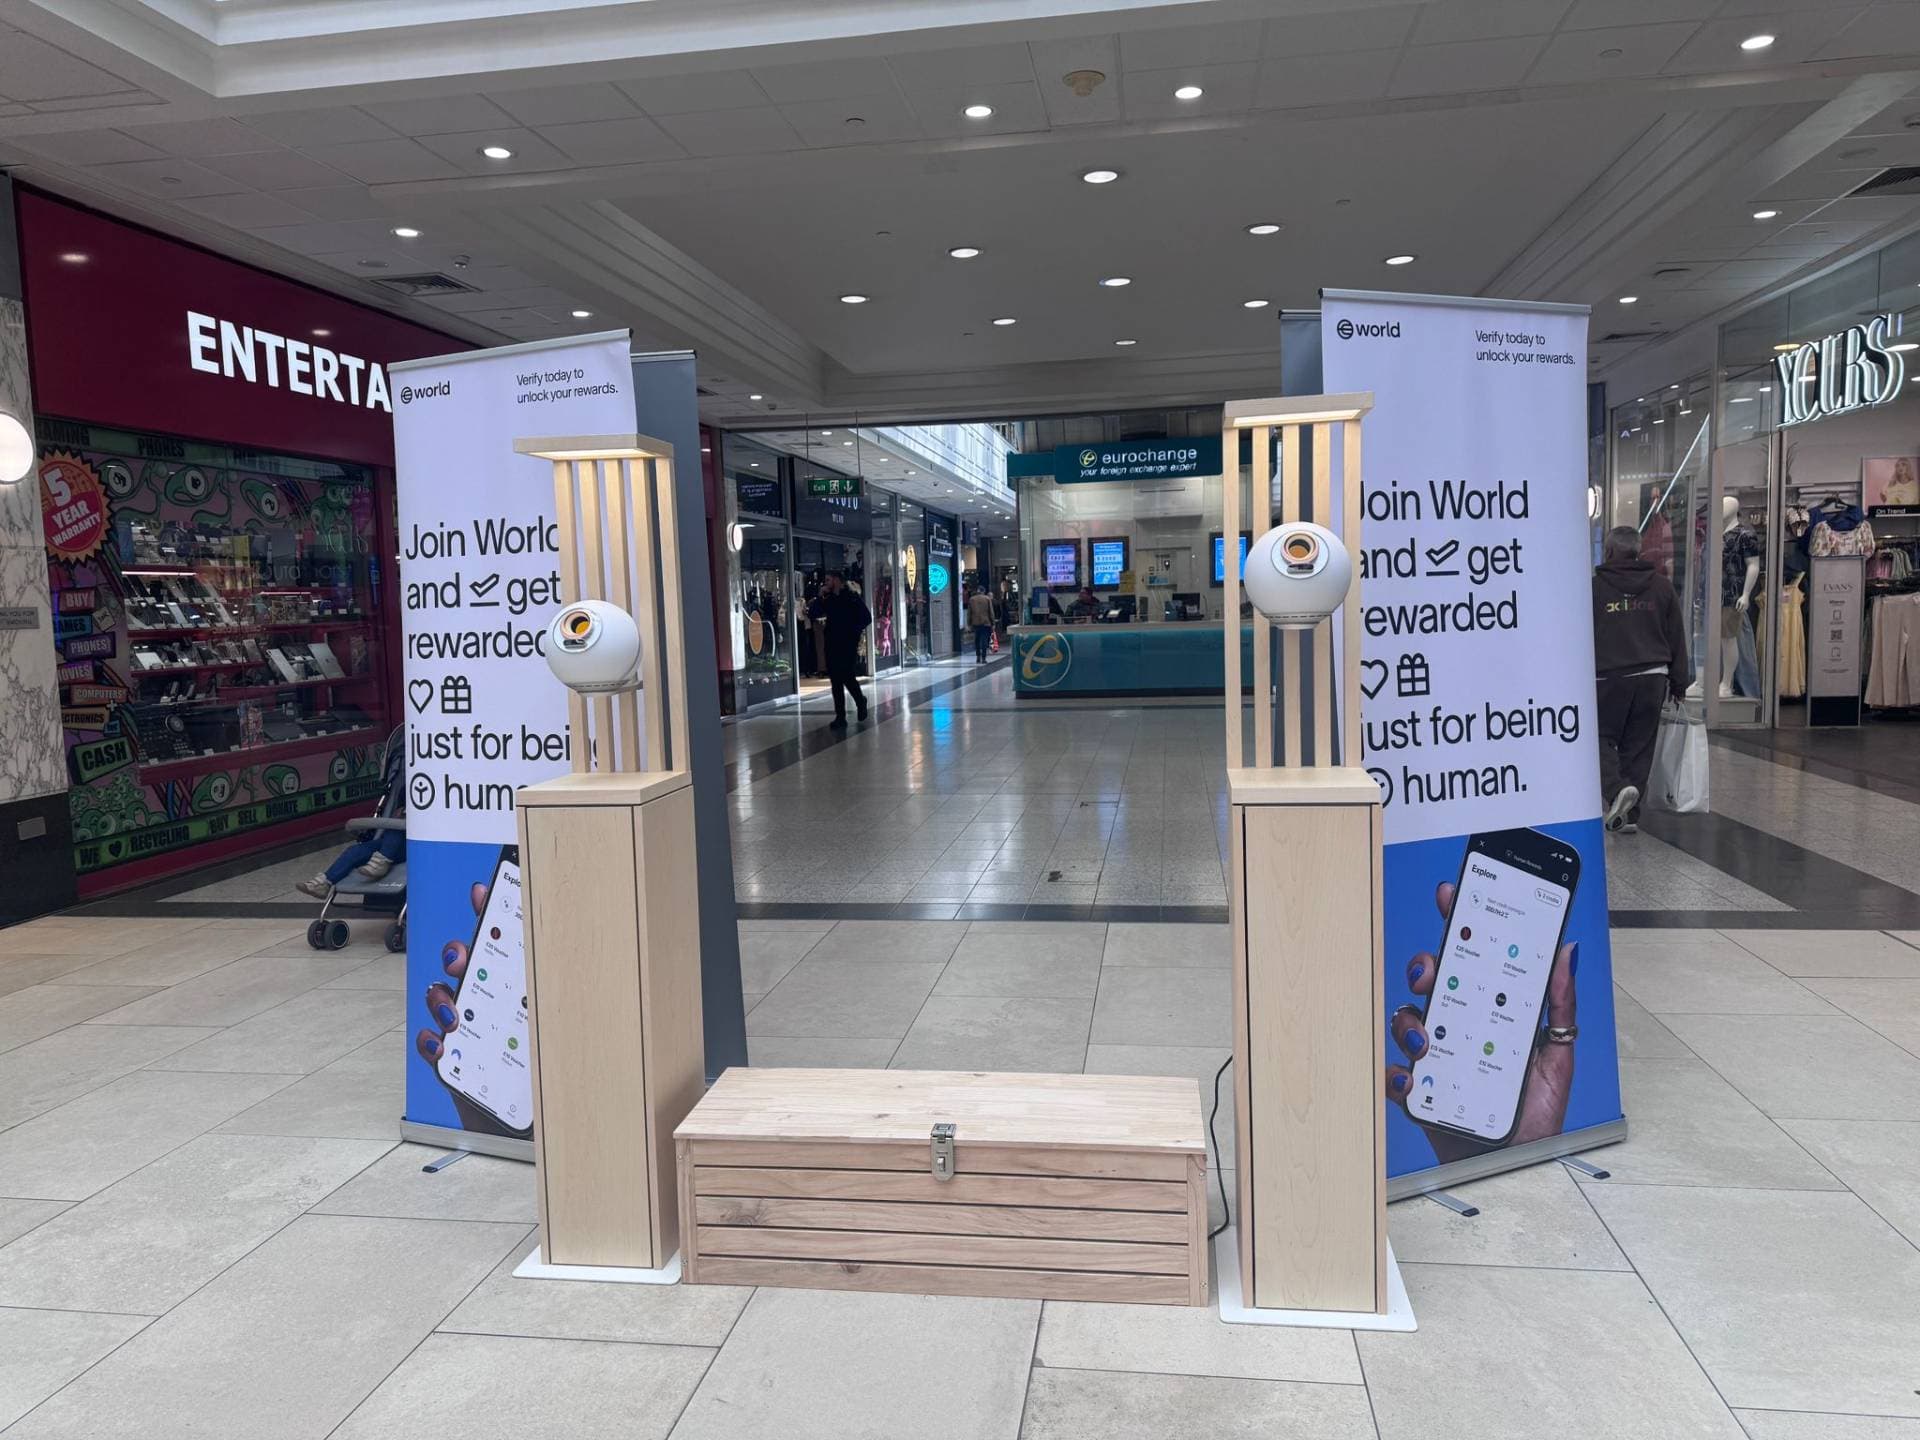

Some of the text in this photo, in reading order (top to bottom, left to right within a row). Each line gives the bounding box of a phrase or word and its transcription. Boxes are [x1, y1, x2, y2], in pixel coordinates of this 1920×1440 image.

[1355, 322, 1401, 338] world
[1475, 330, 1545, 347] Verify today to
[187, 311, 393, 413] ENTERTA
[1476, 350, 1576, 365] unlock your rewards.
[1774, 315, 1905, 427] YOURS
[414, 381, 450, 400] world
[516, 368, 584, 387] Verify today to
[517, 382, 618, 404] unlock your rewards.
[1080, 463, 1197, 478] your foreign exchange expert
[1102, 448, 1198, 464] eurochange
[44, 468, 73, 507] 5
[1429, 480, 1529, 520] World
[52, 500, 92, 529] YEAR
[52, 512, 102, 546] WARRANTY
[405, 521, 466, 560] Join
[1467, 538, 1523, 584] get
[66, 592, 89, 608] BUY
[407, 570, 562, 615] and get
[60, 618, 87, 633] AMES
[1361, 591, 1518, 637] ewarded
[1430, 705, 1477, 746] for
[1485, 698, 1580, 743] being
[82, 742, 127, 771] CASH
[409, 723, 594, 767] just for bei
[444, 774, 527, 811] hum
[1403, 764, 1528, 805] human.
[131, 825, 191, 852] RECYCLING
[209, 815, 230, 835] BUY
[1471, 864, 1498, 881] Explore
